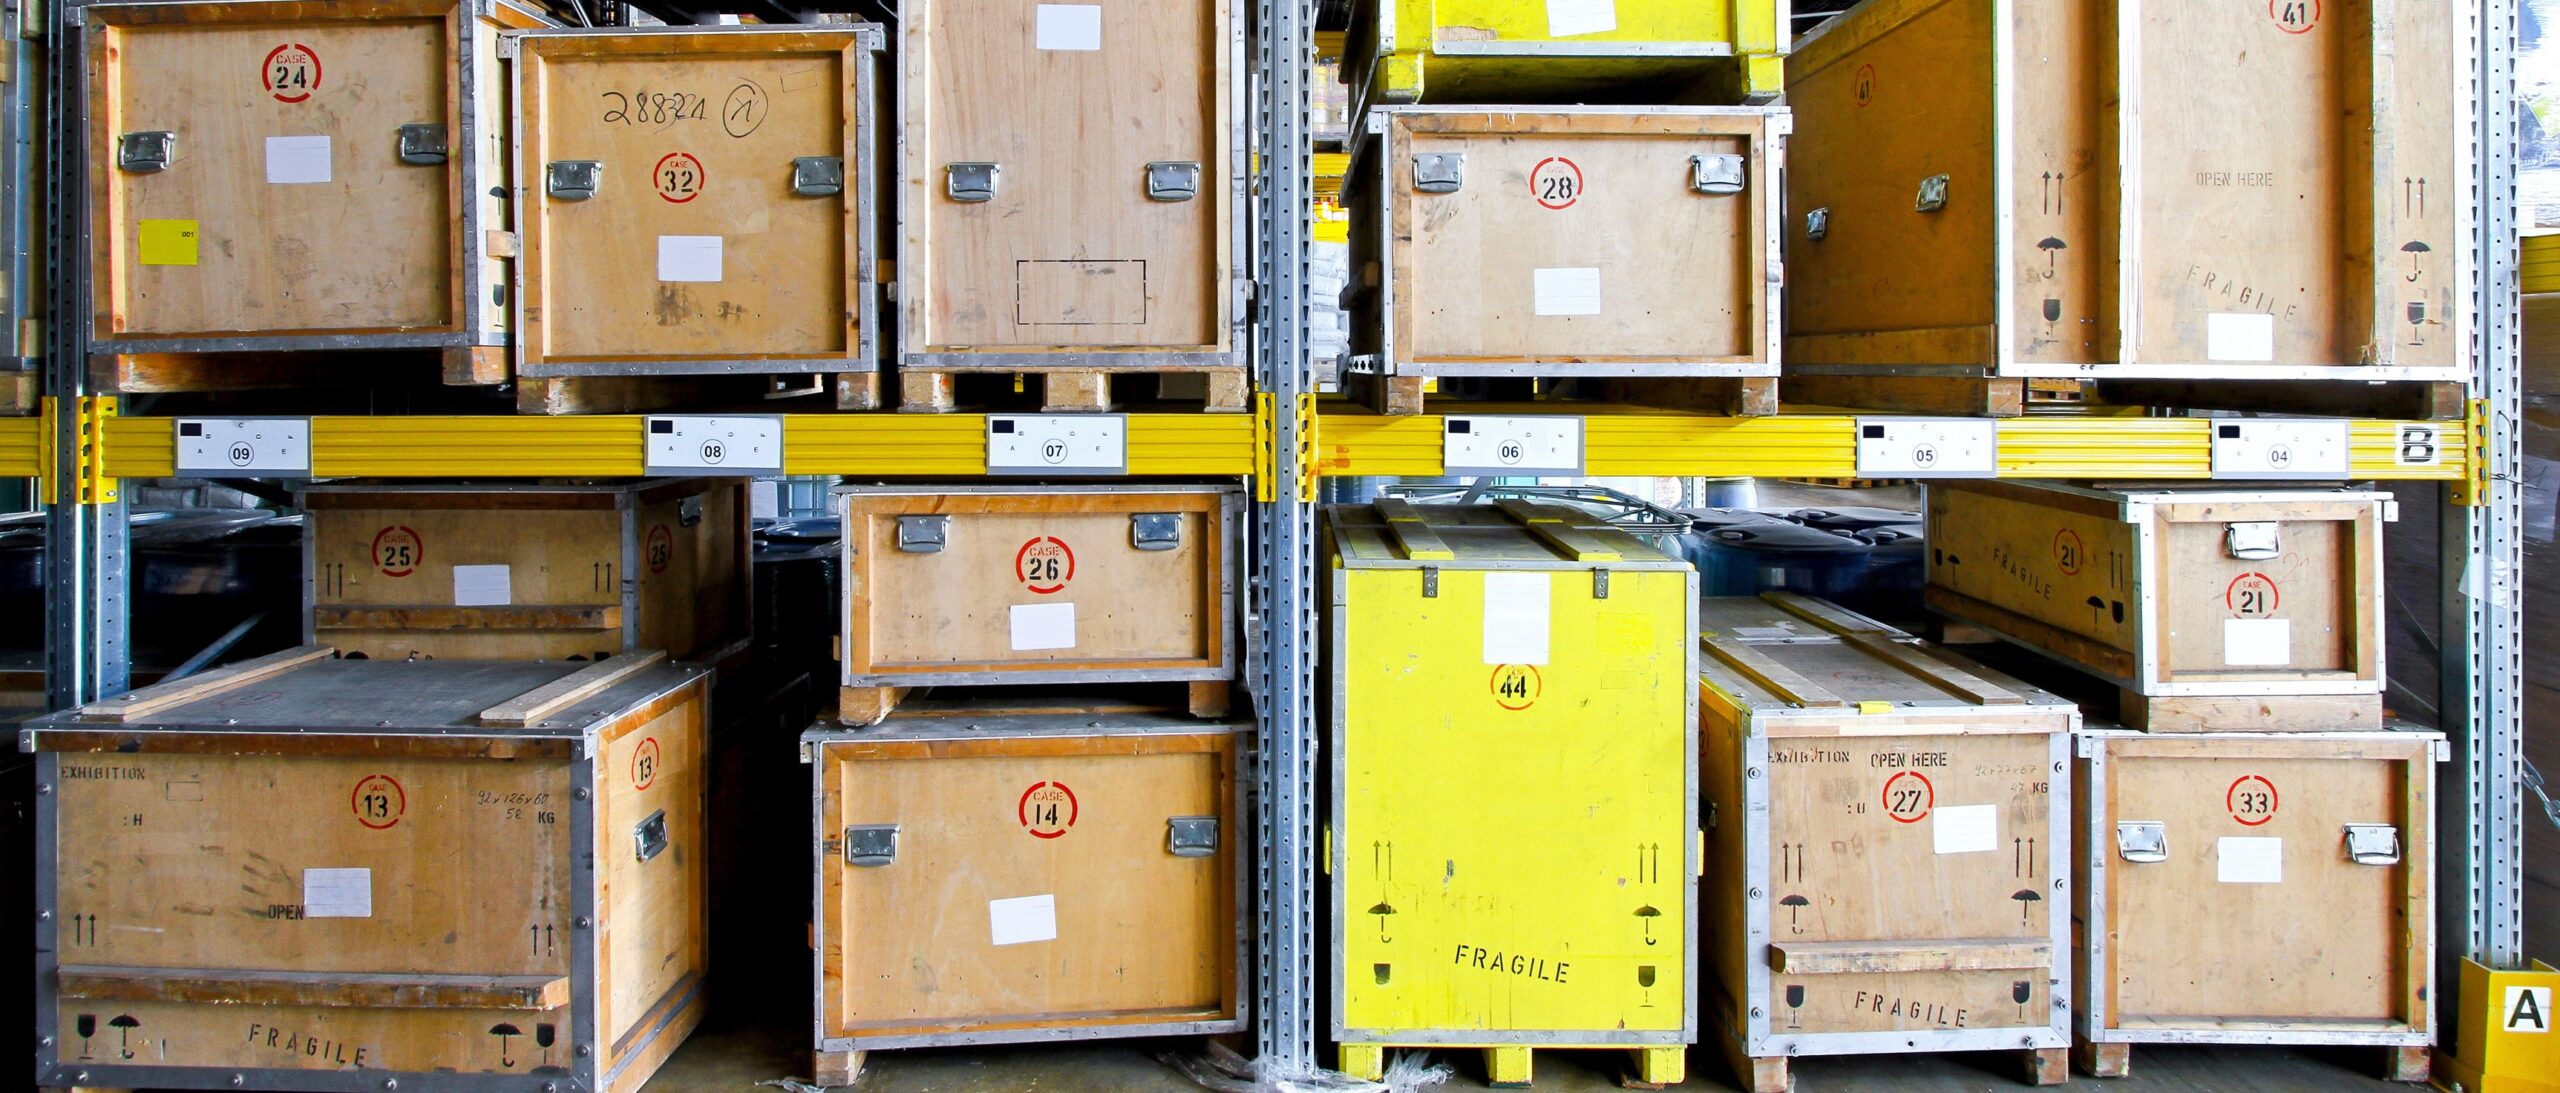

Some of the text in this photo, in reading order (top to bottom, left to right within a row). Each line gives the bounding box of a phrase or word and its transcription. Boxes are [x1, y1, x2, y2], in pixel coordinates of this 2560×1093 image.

[2283, 2, 2305, 25] 41
[276, 54, 306, 64] CASE
[276, 66, 307, 89] 24
[1859, 80, 1869, 100] 41
[670, 160, 688, 168] CASE
[664, 170, 693, 192] 32
[1543, 176, 1572, 199] 28
[2196, 172, 2273, 187] OPEN HERE
[2186, 264, 2297, 323] FRAGILE
[233, 448, 250, 460] 09
[704, 445, 722, 458] 08
[1046, 445, 1063, 457] 07
[1501, 446, 1519, 458] 06
[2402, 426, 2434, 463] B
[1916, 450, 1933, 461] 05
[2271, 450, 2288, 462] 04
[384, 534, 410, 544] CASE
[384, 546, 410, 566] 25
[651, 545, 666, 565] 25
[1030, 546, 1059, 556] CASE
[2061, 545, 2074, 568] 21
[1029, 558, 1058, 580] 26
[1993, 547, 2051, 600] FRAGILE
[2243, 580, 2262, 588] CASE
[2241, 591, 2263, 613] 21
[1500, 675, 1526, 698] 44
[639, 756, 651, 781] 13
[1870, 752, 1948, 768] OPEN HERE
[61, 766, 146, 780] EXHIBITION
[1033, 791, 1063, 801] CASE
[2032, 782, 2048, 793] KG
[364, 795, 388, 818] 13
[1893, 790, 1922, 812] 27
[2240, 792, 2268, 813] 33
[538, 811, 555, 824] KG
[1036, 803, 1058, 825] 14
[268, 904, 304, 920] OPEN
[1455, 944, 1570, 984] FRAGILE
[1855, 990, 1967, 1028] FRAGILE
[2507, 989, 2544, 1029] A
[248, 1022, 368, 1068] FRAGILE
